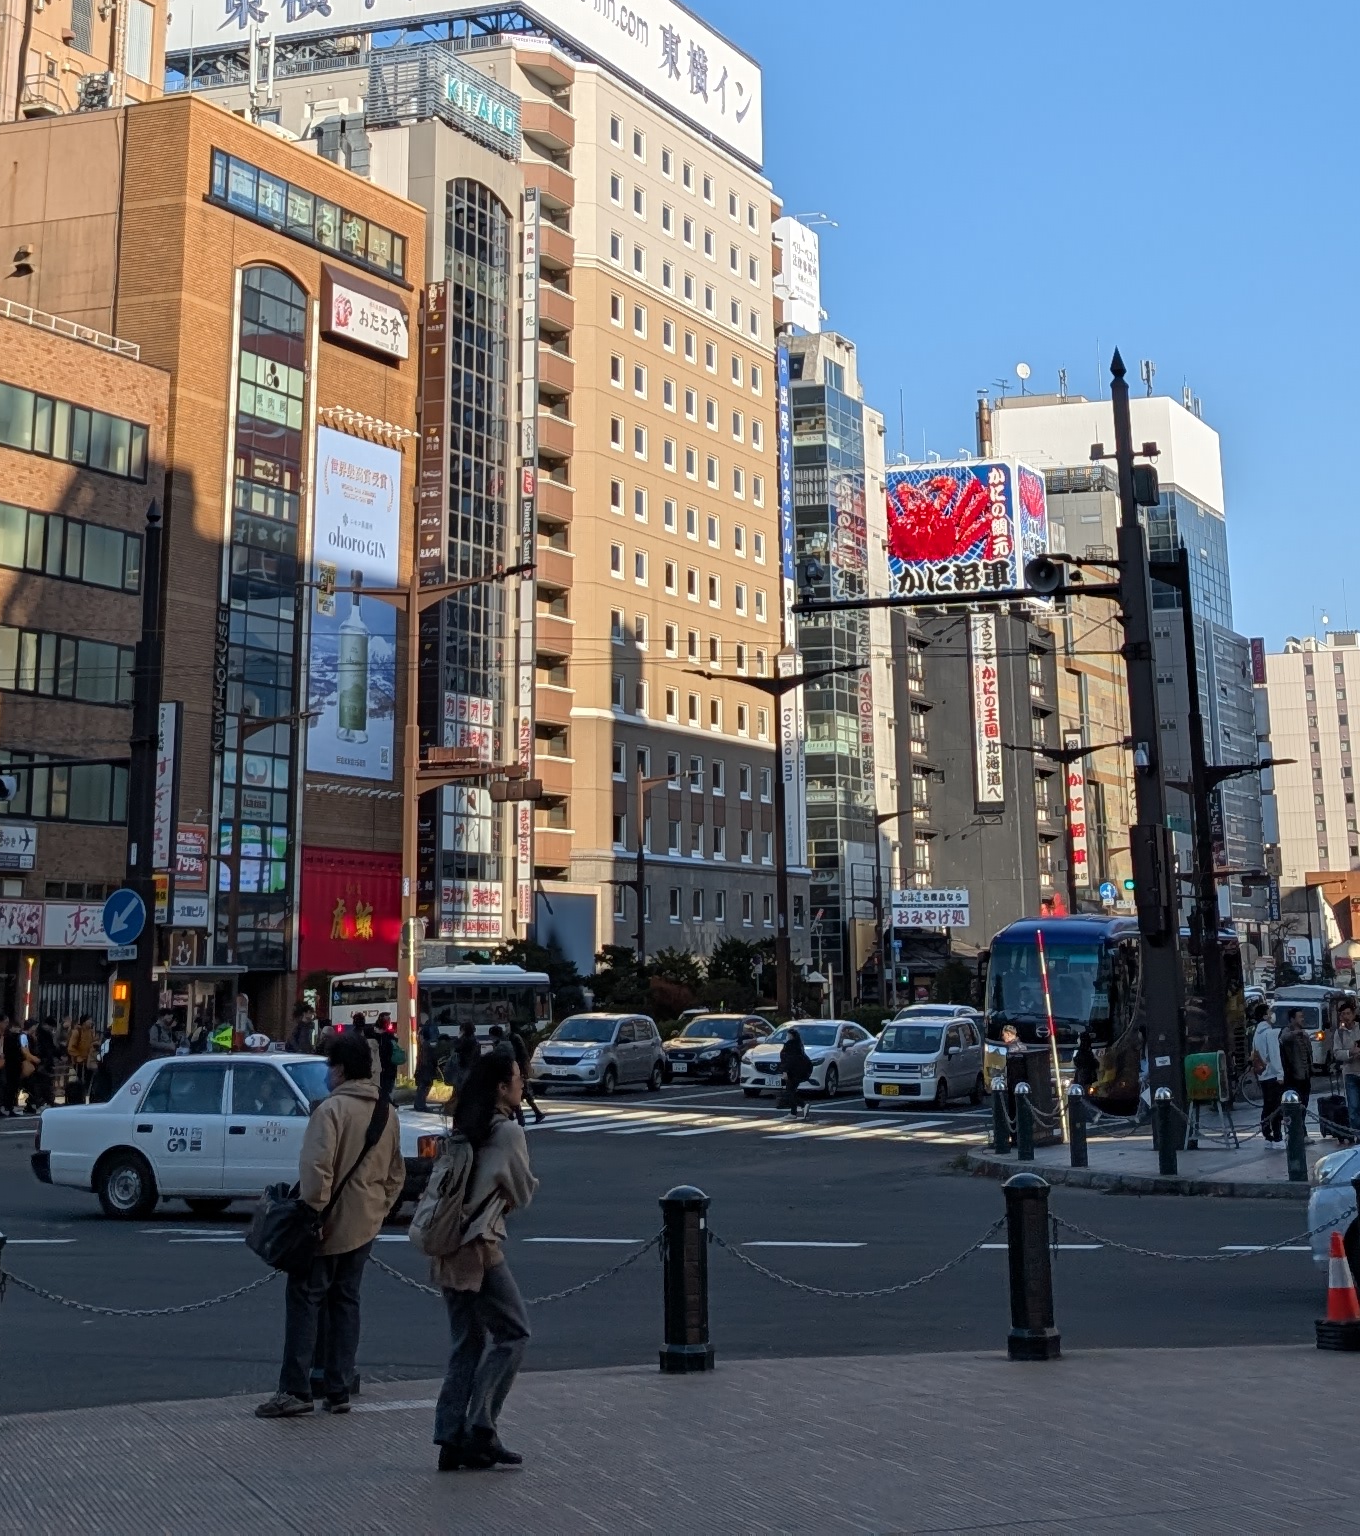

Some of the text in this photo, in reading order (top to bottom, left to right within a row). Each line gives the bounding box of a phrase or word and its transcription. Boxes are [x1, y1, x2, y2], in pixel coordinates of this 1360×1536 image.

[658, 22, 753, 125] 東横イン
[328, 526, 387, 560] ohoro GIN
[897, 561, 1011, 594] かに将軍
[444, 697, 493, 722] カラオケ
[213, 704, 226, 752] NEW
[783, 707, 795, 782] toyoko inn
[897, 909, 966, 925] おみやげ処
[167, 1138, 188, 1153] GO
[169, 1126, 189, 1137] TAXI
